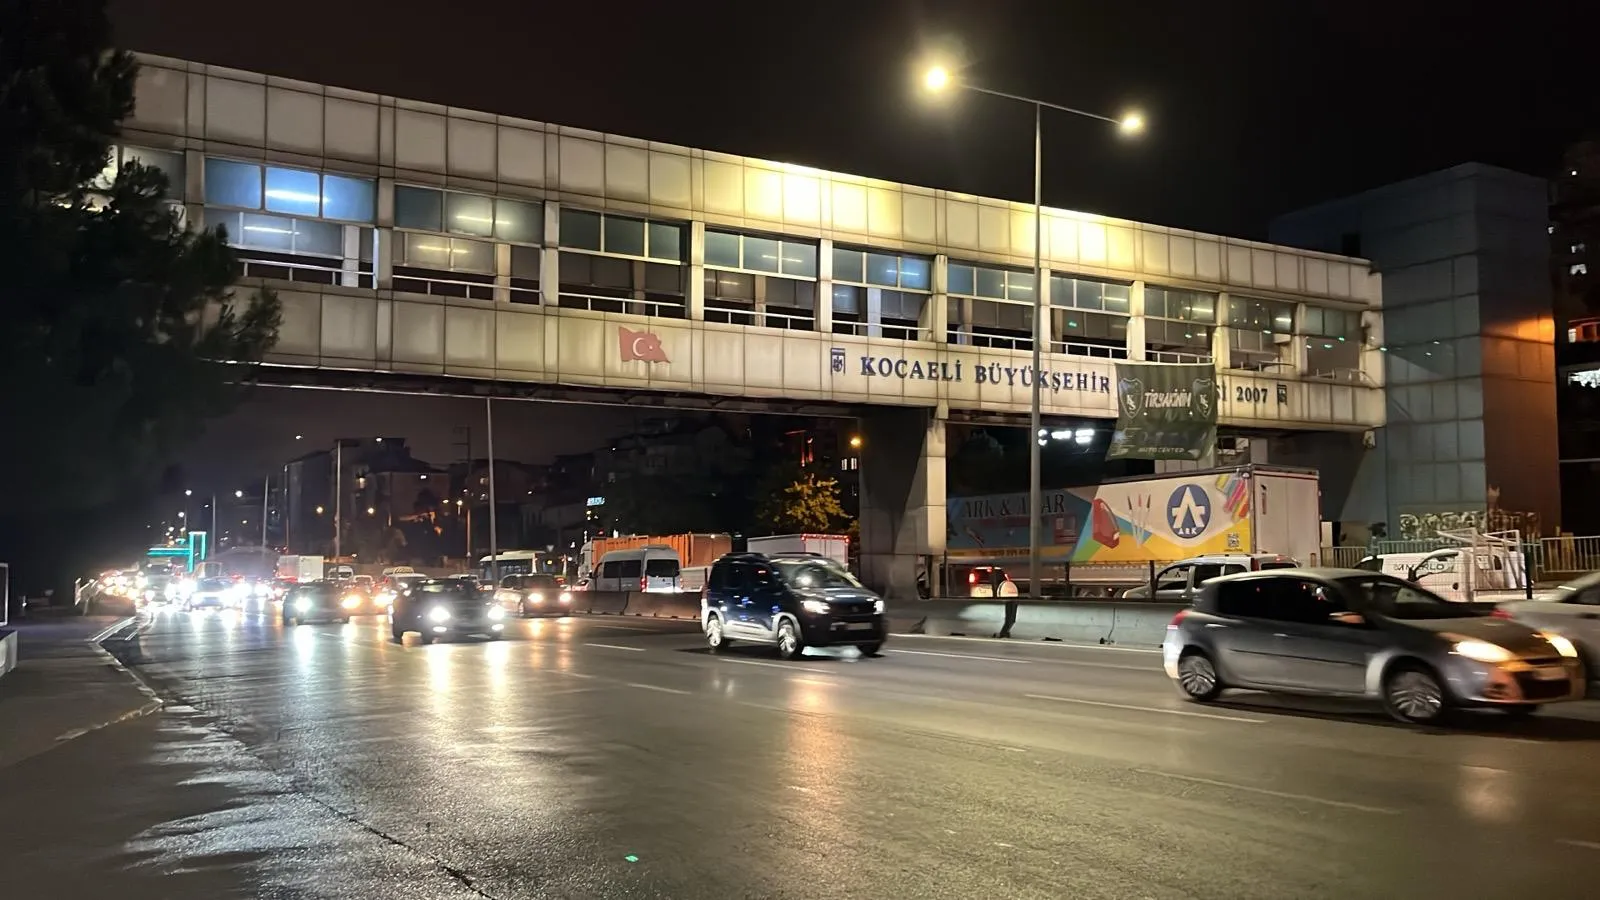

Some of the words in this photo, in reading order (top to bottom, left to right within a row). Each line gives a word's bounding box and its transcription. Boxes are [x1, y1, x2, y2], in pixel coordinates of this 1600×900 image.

[861, 357, 961, 382] KOCAELİ
[975, 364, 1110, 395] BÜYÜKŞEHİR
[1236, 386, 1268, 404] 2007
[1178, 527, 1197, 535] ARK
